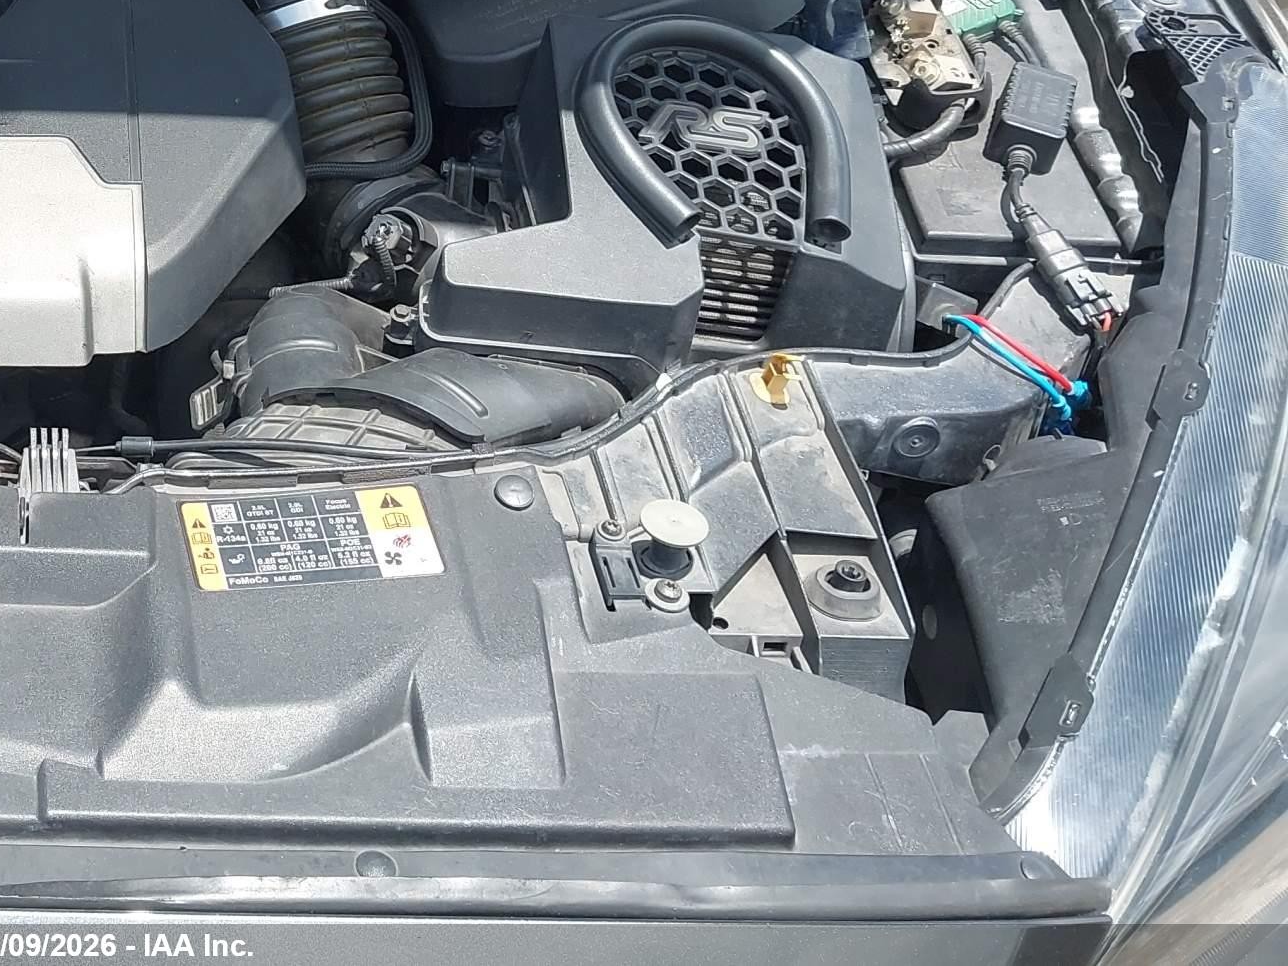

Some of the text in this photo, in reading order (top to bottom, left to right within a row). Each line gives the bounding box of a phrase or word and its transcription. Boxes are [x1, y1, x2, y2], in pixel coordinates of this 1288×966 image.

[639, 99, 769, 155] RS
[341, 538, 361, 546] POE
[229, 577, 269, 585] FoMoCo
